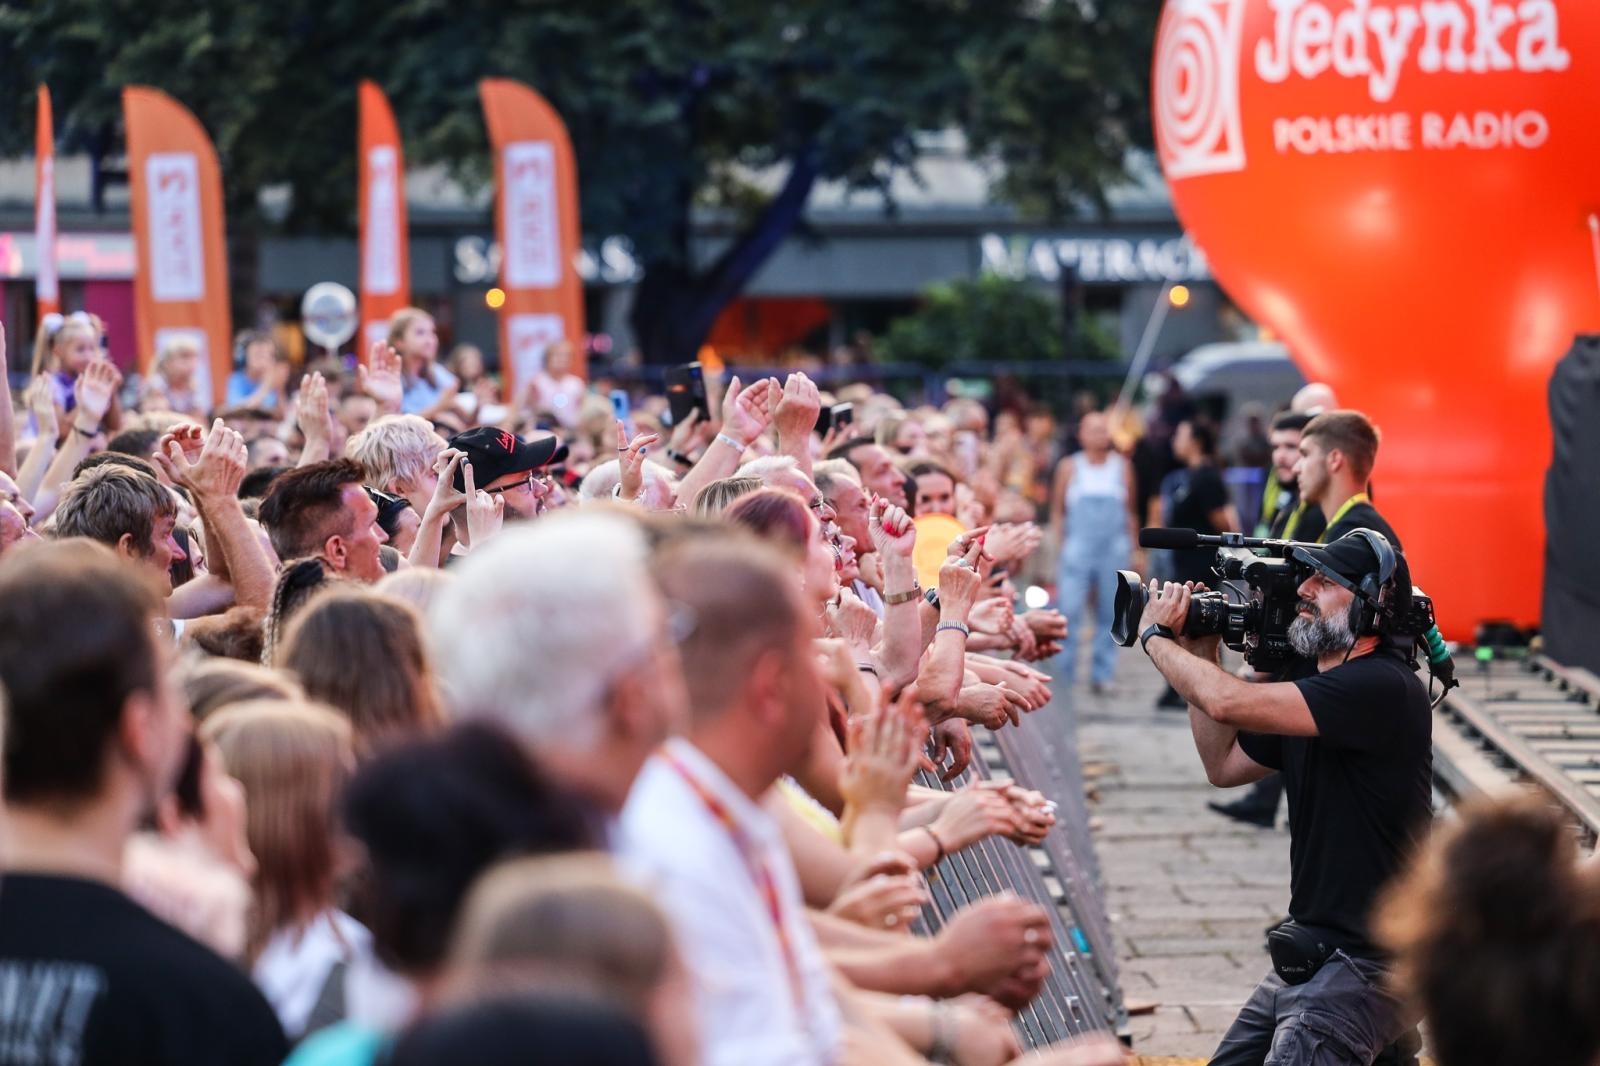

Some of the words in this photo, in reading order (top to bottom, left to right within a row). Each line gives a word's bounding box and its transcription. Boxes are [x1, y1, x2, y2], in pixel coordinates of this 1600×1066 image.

[1254, 0, 1570, 102] Jedynka
[1273, 113, 1413, 154] POLSKIE
[1421, 109, 1549, 150] RADIO
